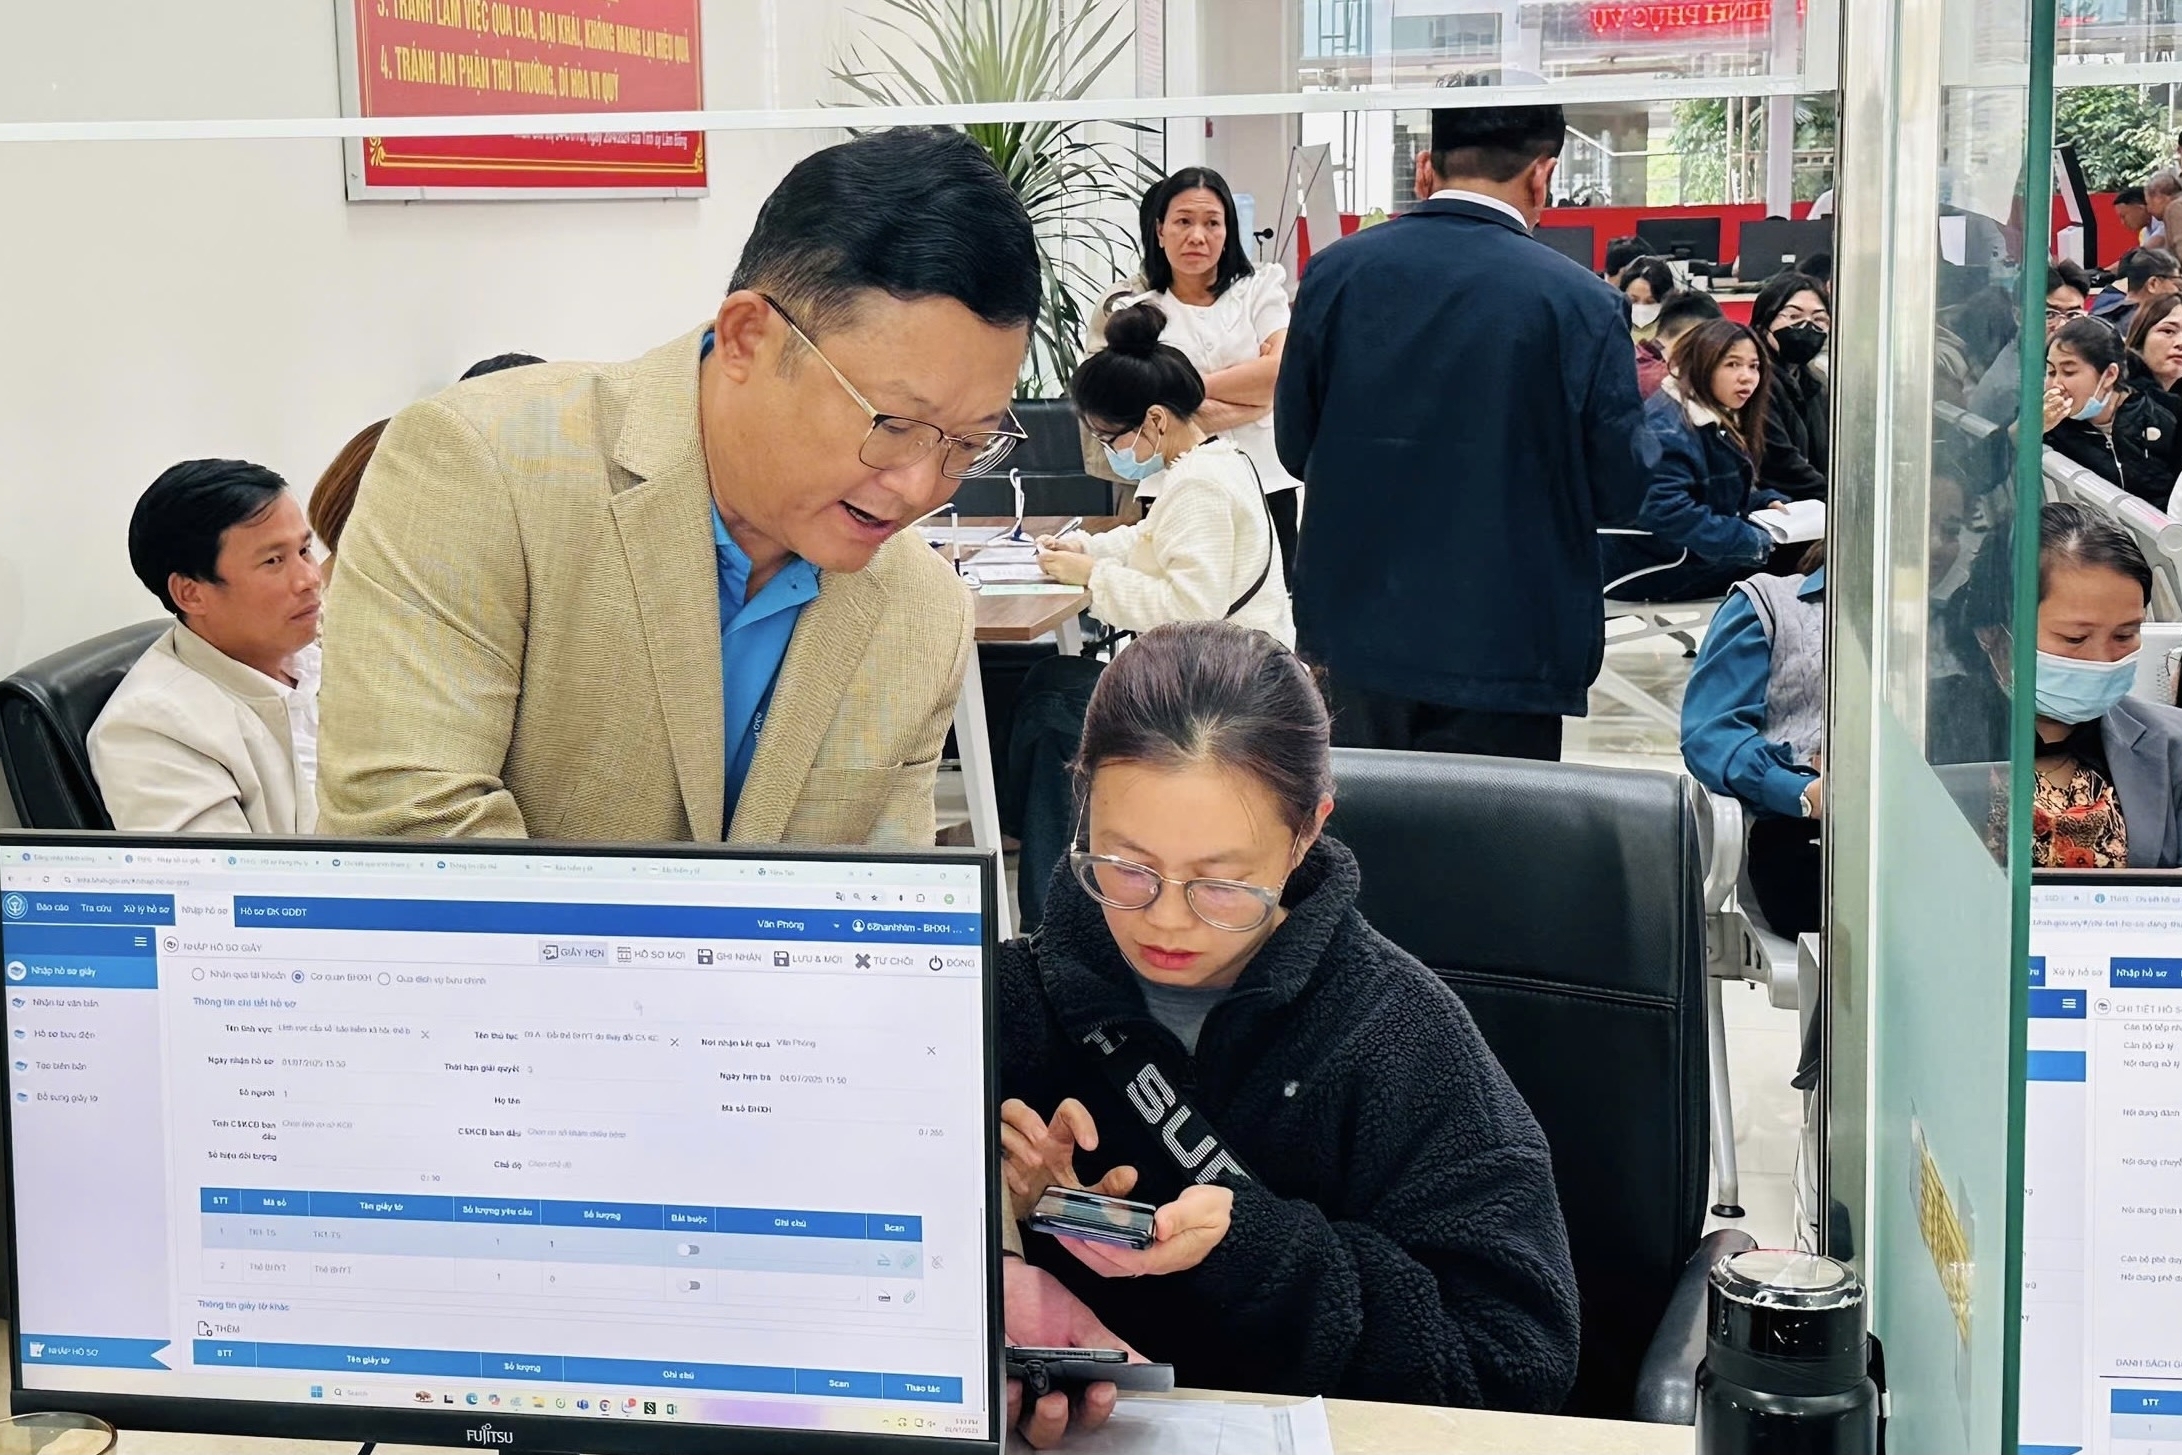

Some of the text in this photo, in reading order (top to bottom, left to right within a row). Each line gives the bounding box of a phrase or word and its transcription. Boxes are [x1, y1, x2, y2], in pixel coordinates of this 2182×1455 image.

[492, 2, 513, 37] QUA
[515, 6, 537, 43] LOA,
[558, 10, 583, 50] KHÁI,
[585, 14, 615, 51] KHÔNG
[616, 25, 641, 56] MANG
[642, 30, 655, 64] LẠI
[381, 45, 392, 79] 4.
[395, 40, 436, 84] TRÁNH
[440, 52, 456, 85] AN
[459, 49, 490, 96] PHẬN
[492, 49, 512, 91] THỦ
[515, 56, 557, 99] THƯỜNG,
[571, 63, 589, 99] HÒA
[591, 71, 600, 100] VI
[602, 68, 619, 104] QUÝ
[81, 904, 94, 912] Tra
[467, 1423, 513, 1445] FUJITSU
